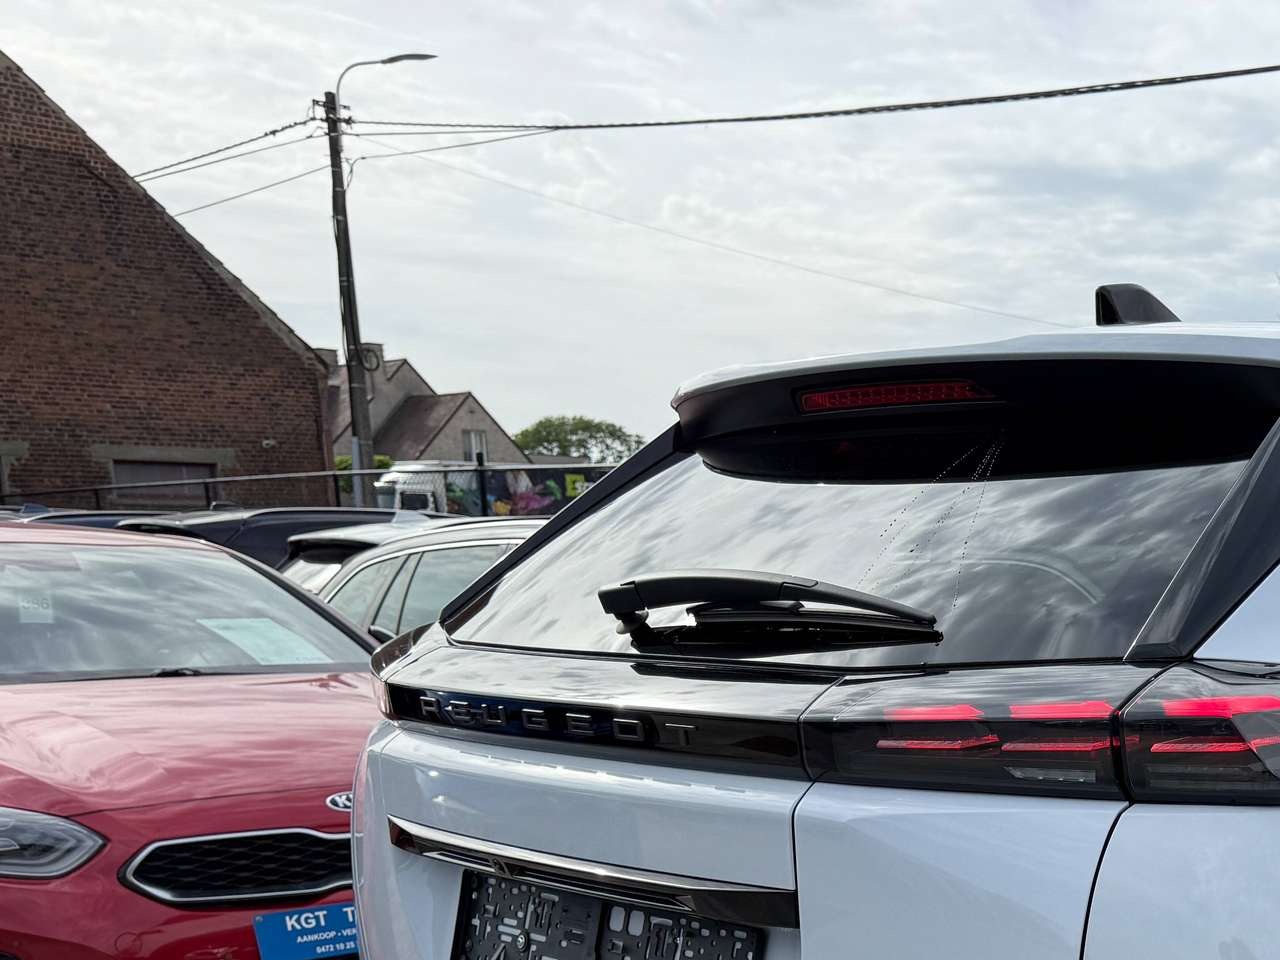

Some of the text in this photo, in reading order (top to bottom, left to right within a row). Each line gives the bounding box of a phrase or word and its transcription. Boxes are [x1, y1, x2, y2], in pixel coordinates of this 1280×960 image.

[285, 906, 357, 932] KGT T
[296, 930, 337, 944] AANKOOP
